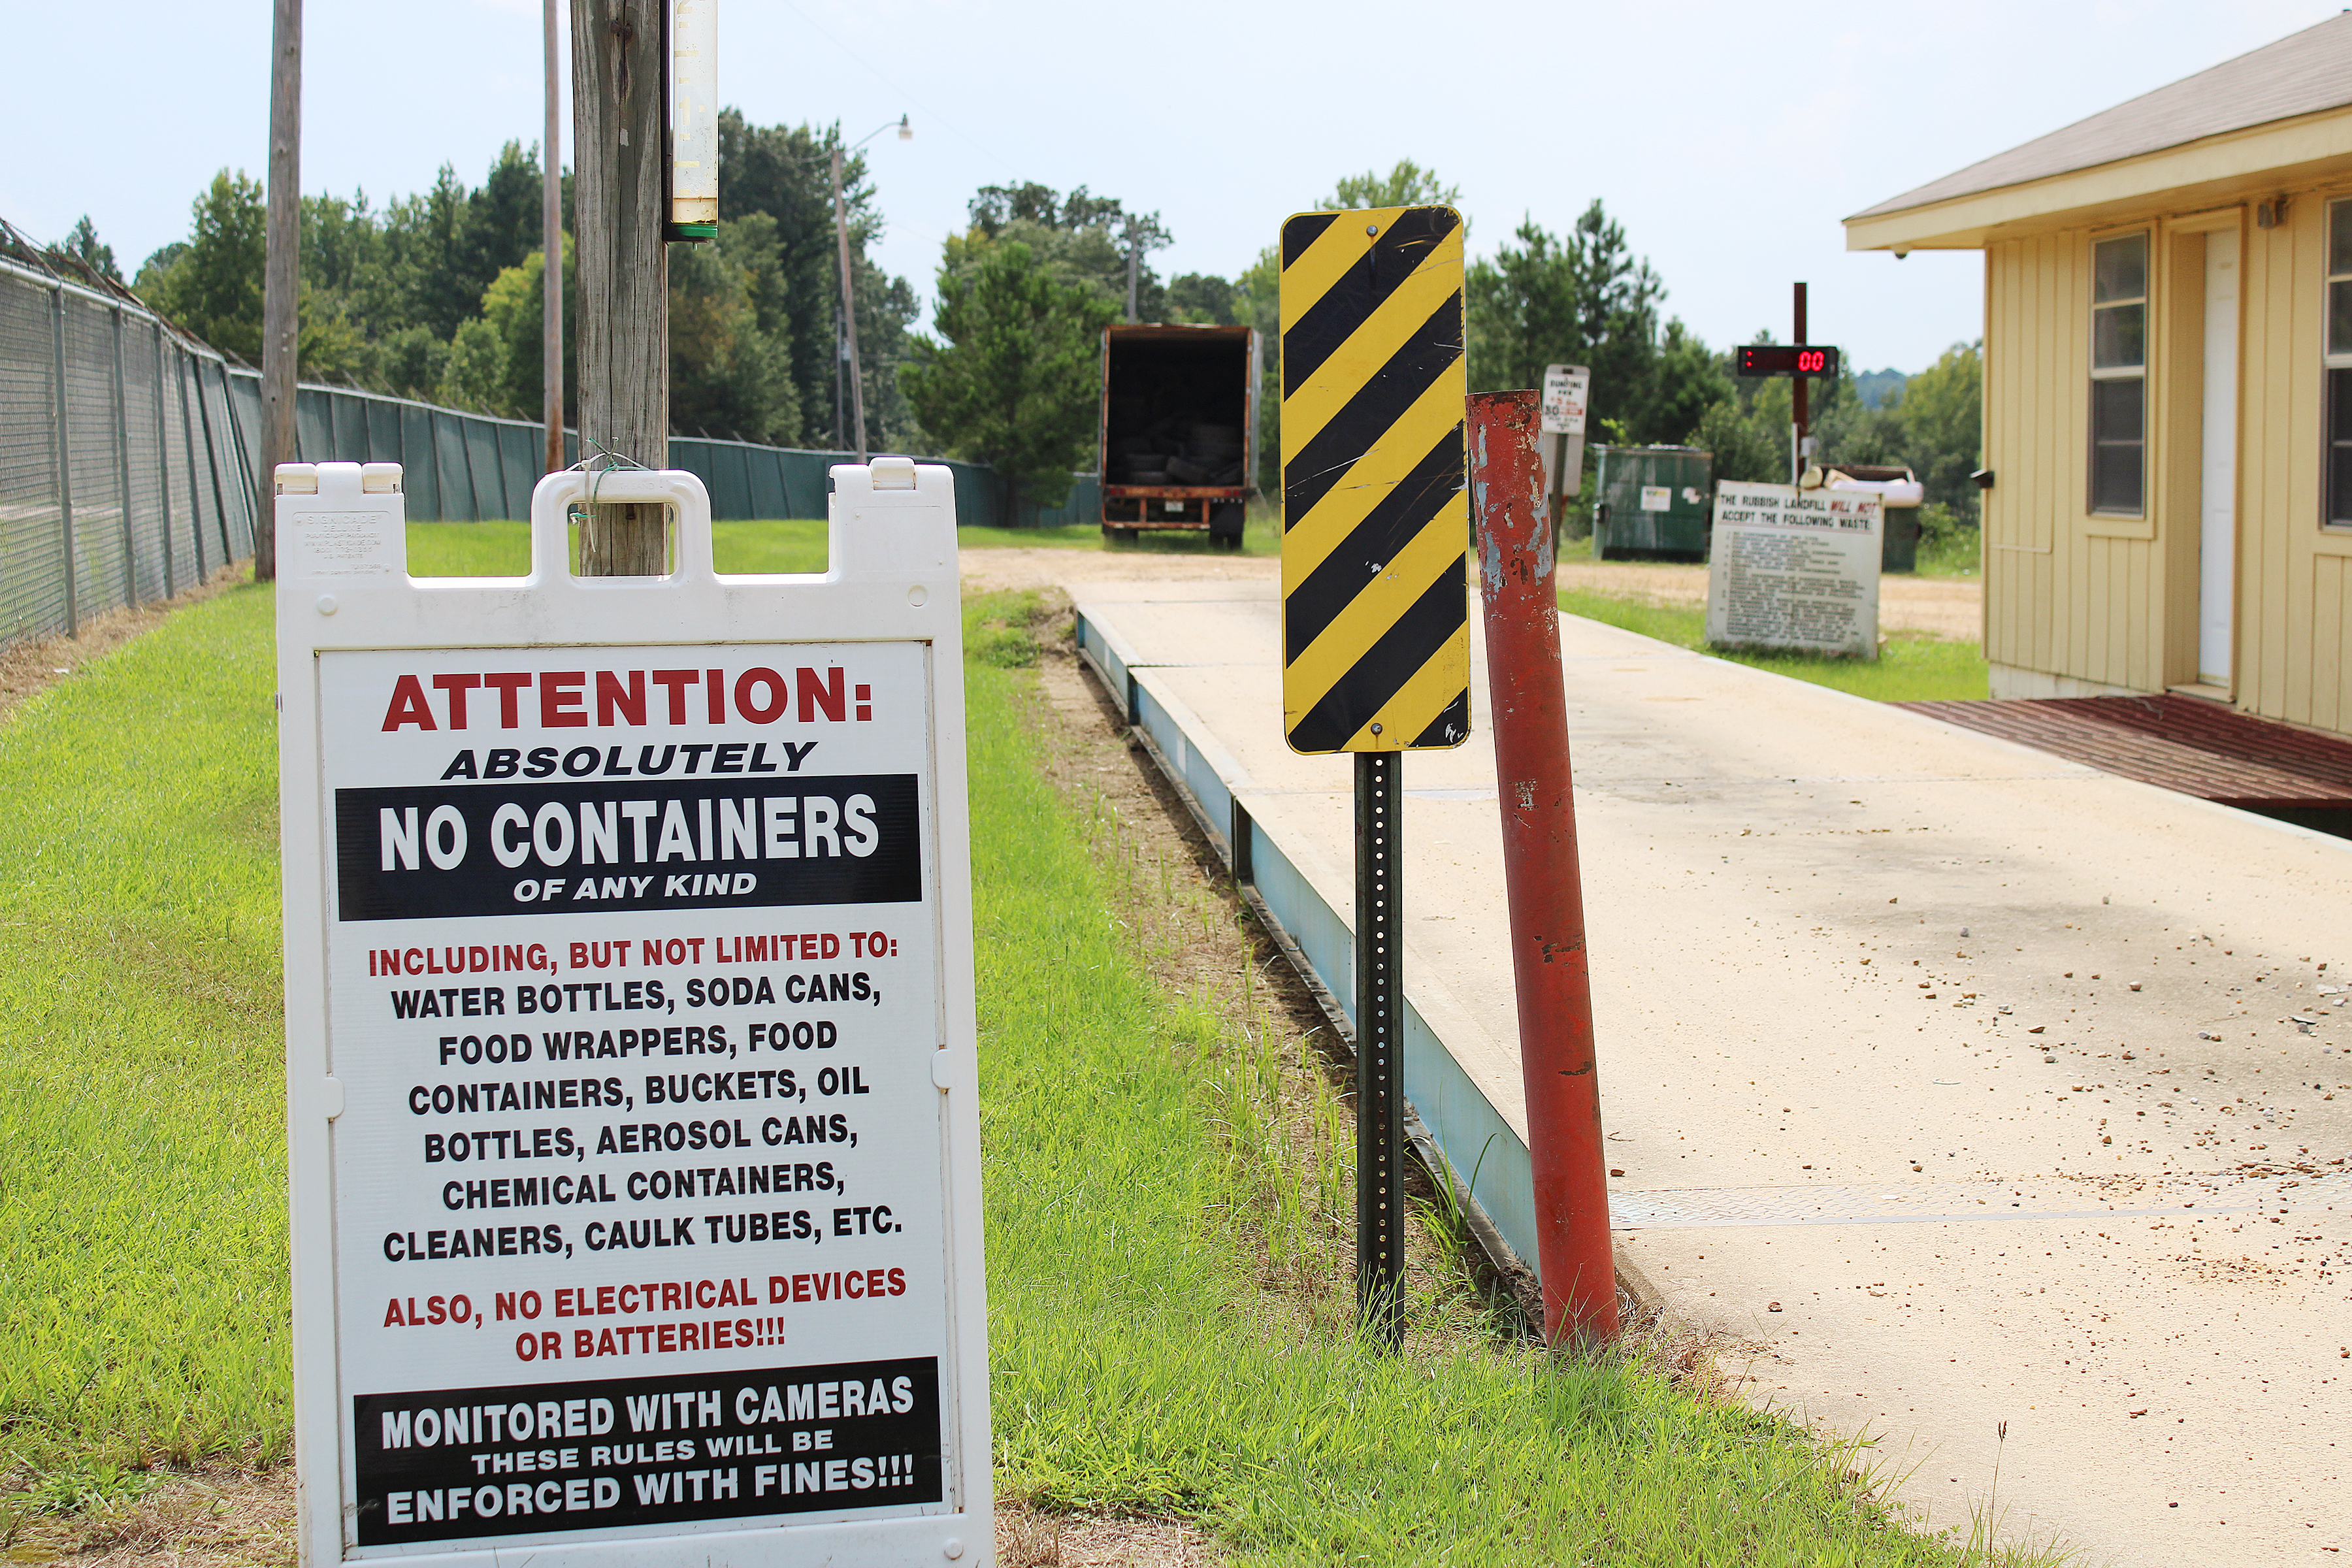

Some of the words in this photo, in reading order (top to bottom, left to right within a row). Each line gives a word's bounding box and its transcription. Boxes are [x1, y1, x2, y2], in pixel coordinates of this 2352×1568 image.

[1798, 351, 1825, 372] 00
[1721, 495, 1737, 506] THE
[1742, 496, 1780, 508] RUBBISH
[1785, 499, 1826, 510] LANDFILL
[1830, 500, 1851, 513] WILL
[1856, 501, 1878, 514] NOT
[1722, 510, 1756, 521] ACCEPT
[1761, 512, 1777, 523] THE
[1783, 514, 1834, 527] FOLLOWING
[382, 667, 872, 731] ATTENTION:
[440, 742, 818, 780] ABSOLUTELY
[381, 805, 467, 871] NO
[491, 794, 878, 868] CONTAINERS
[514, 879, 566, 902] OF
[573, 876, 654, 900] ANY
[664, 874, 756, 896] KIND
[370, 943, 557, 976] INCLUDING,
[570, 941, 631, 968] BUT
[644, 938, 704, 966] NOT
[717, 934, 840, 962] LIMITED
[849, 932, 897, 958] TO:
[391, 987, 504, 1019] WATER
[517, 981, 674, 1015] BOTTLES,
[687, 977, 776, 1007] SODA
[786, 972, 880, 1006] CANS,
[440, 1034, 532, 1065] FOOD
[542, 1025, 736, 1060] WRAPPERS,
[749, 1021, 836, 1052] FOOD
[409, 1077, 632, 1115] CONTAINERS,
[646, 1070, 806, 1104] BUCKETS,
[818, 1066, 869, 1096] OIL
[425, 1128, 584, 1163] BOTTLES,
[596, 1119, 751, 1154] AEROSOL
[762, 1114, 857, 1148] CANS,
[443, 1174, 615, 1210] CHEMICAL
[627, 1162, 843, 1201] CONTAINERS,
[384, 1224, 572, 1262] CLEANERS,
[585, 1217, 695, 1251] CAULK
[705, 1211, 821, 1245] TUBES,
[834, 1205, 902, 1236] ETC.
[384, 1294, 482, 1329] ALSO,
[496, 1290, 542, 1320] NO
[555, 1278, 757, 1317] ELECTRICAL
[769, 1268, 906, 1303] DEVICES
[516, 1331, 562, 1361] OR
[575, 1317, 784, 1358] BATTERIES!!!
[383, 1399, 613, 1448] MONITORED
[626, 1390, 721, 1431] WITH
[736, 1377, 913, 1424] CAMERAS
[472, 1448, 578, 1474] THESE
[592, 1441, 695, 1466] RULES
[706, 1434, 781, 1457] WILL
[793, 1430, 832, 1451] BE
[388, 1478, 619, 1524] ENFORCED
[634, 1469, 738, 1505] WITH
[755, 1455, 913, 1495] FINES!!!
